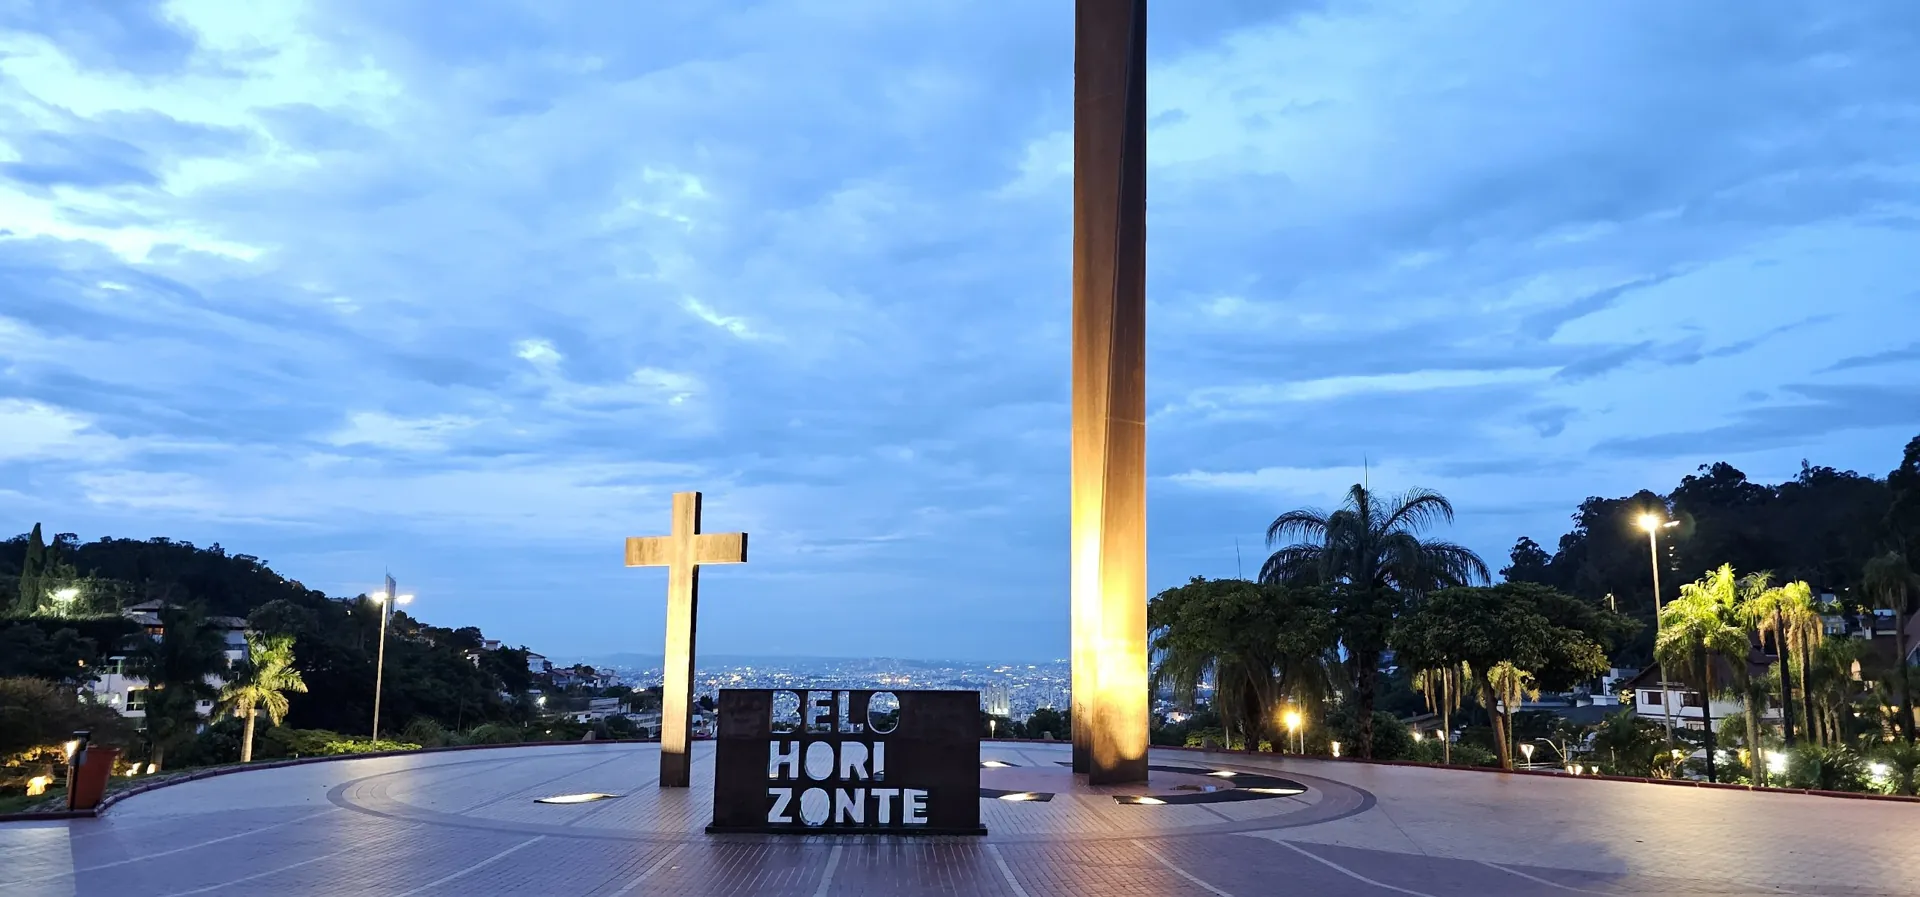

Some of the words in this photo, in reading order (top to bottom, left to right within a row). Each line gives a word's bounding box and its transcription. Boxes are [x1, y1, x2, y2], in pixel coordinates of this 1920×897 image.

[770, 691, 900, 734] BELO
[768, 740, 885, 781] HORI
[767, 787, 928, 826] ZONTE
